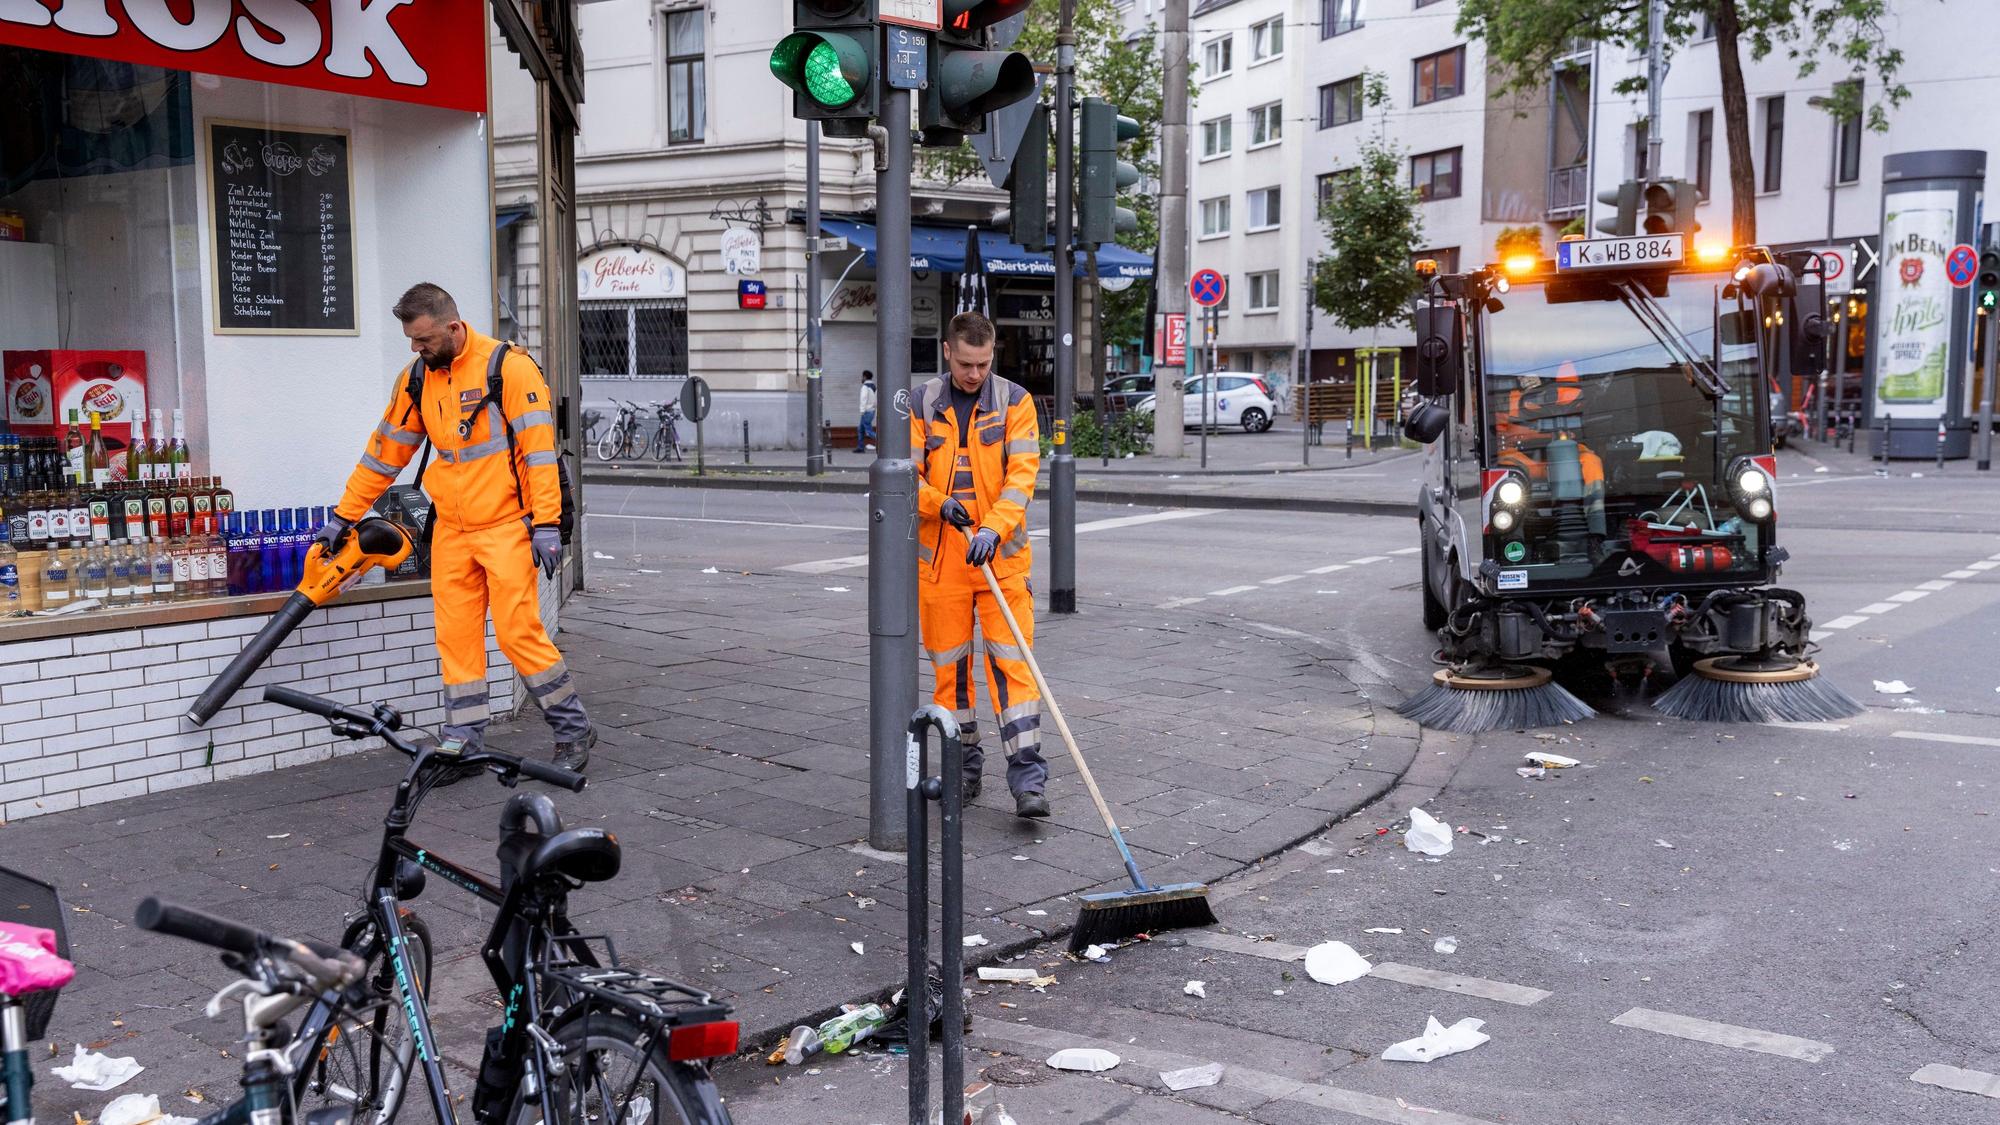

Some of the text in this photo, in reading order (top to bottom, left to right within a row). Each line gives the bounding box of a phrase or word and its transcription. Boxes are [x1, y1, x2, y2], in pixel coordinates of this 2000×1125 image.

[899, 30, 926, 46] S 150
[247, 185, 273, 198] Zucker
[228, 206, 262, 220] Apfelmus
[265, 209, 282, 221] Zimt
[229, 218, 256, 229] Nutella
[229, 229, 255, 239] Nutella
[259, 230, 274, 240] Zimt
[230, 240, 256, 249] Nutella
[1908, 233, 1946, 265] BEAM
[231, 250, 253, 261] Kinder
[256, 252, 277, 263] Riegel
[1579, 244, 1591, 264] K
[1605, 242, 1631, 261] WB
[1636, 240, 1673, 259] 884
[231, 260, 253, 272] Kinder
[257, 263, 277, 273] Bueno
[594, 255, 655, 288] Gilbert's
[231, 272, 251, 283] Duplo
[610, 279, 641, 293] Pinte
[747, 283, 760, 294] sky
[255, 294, 285, 305] Schinken
[93, 390, 118, 409] früh
[392, 958, 429, 1063] PEUGEOT
